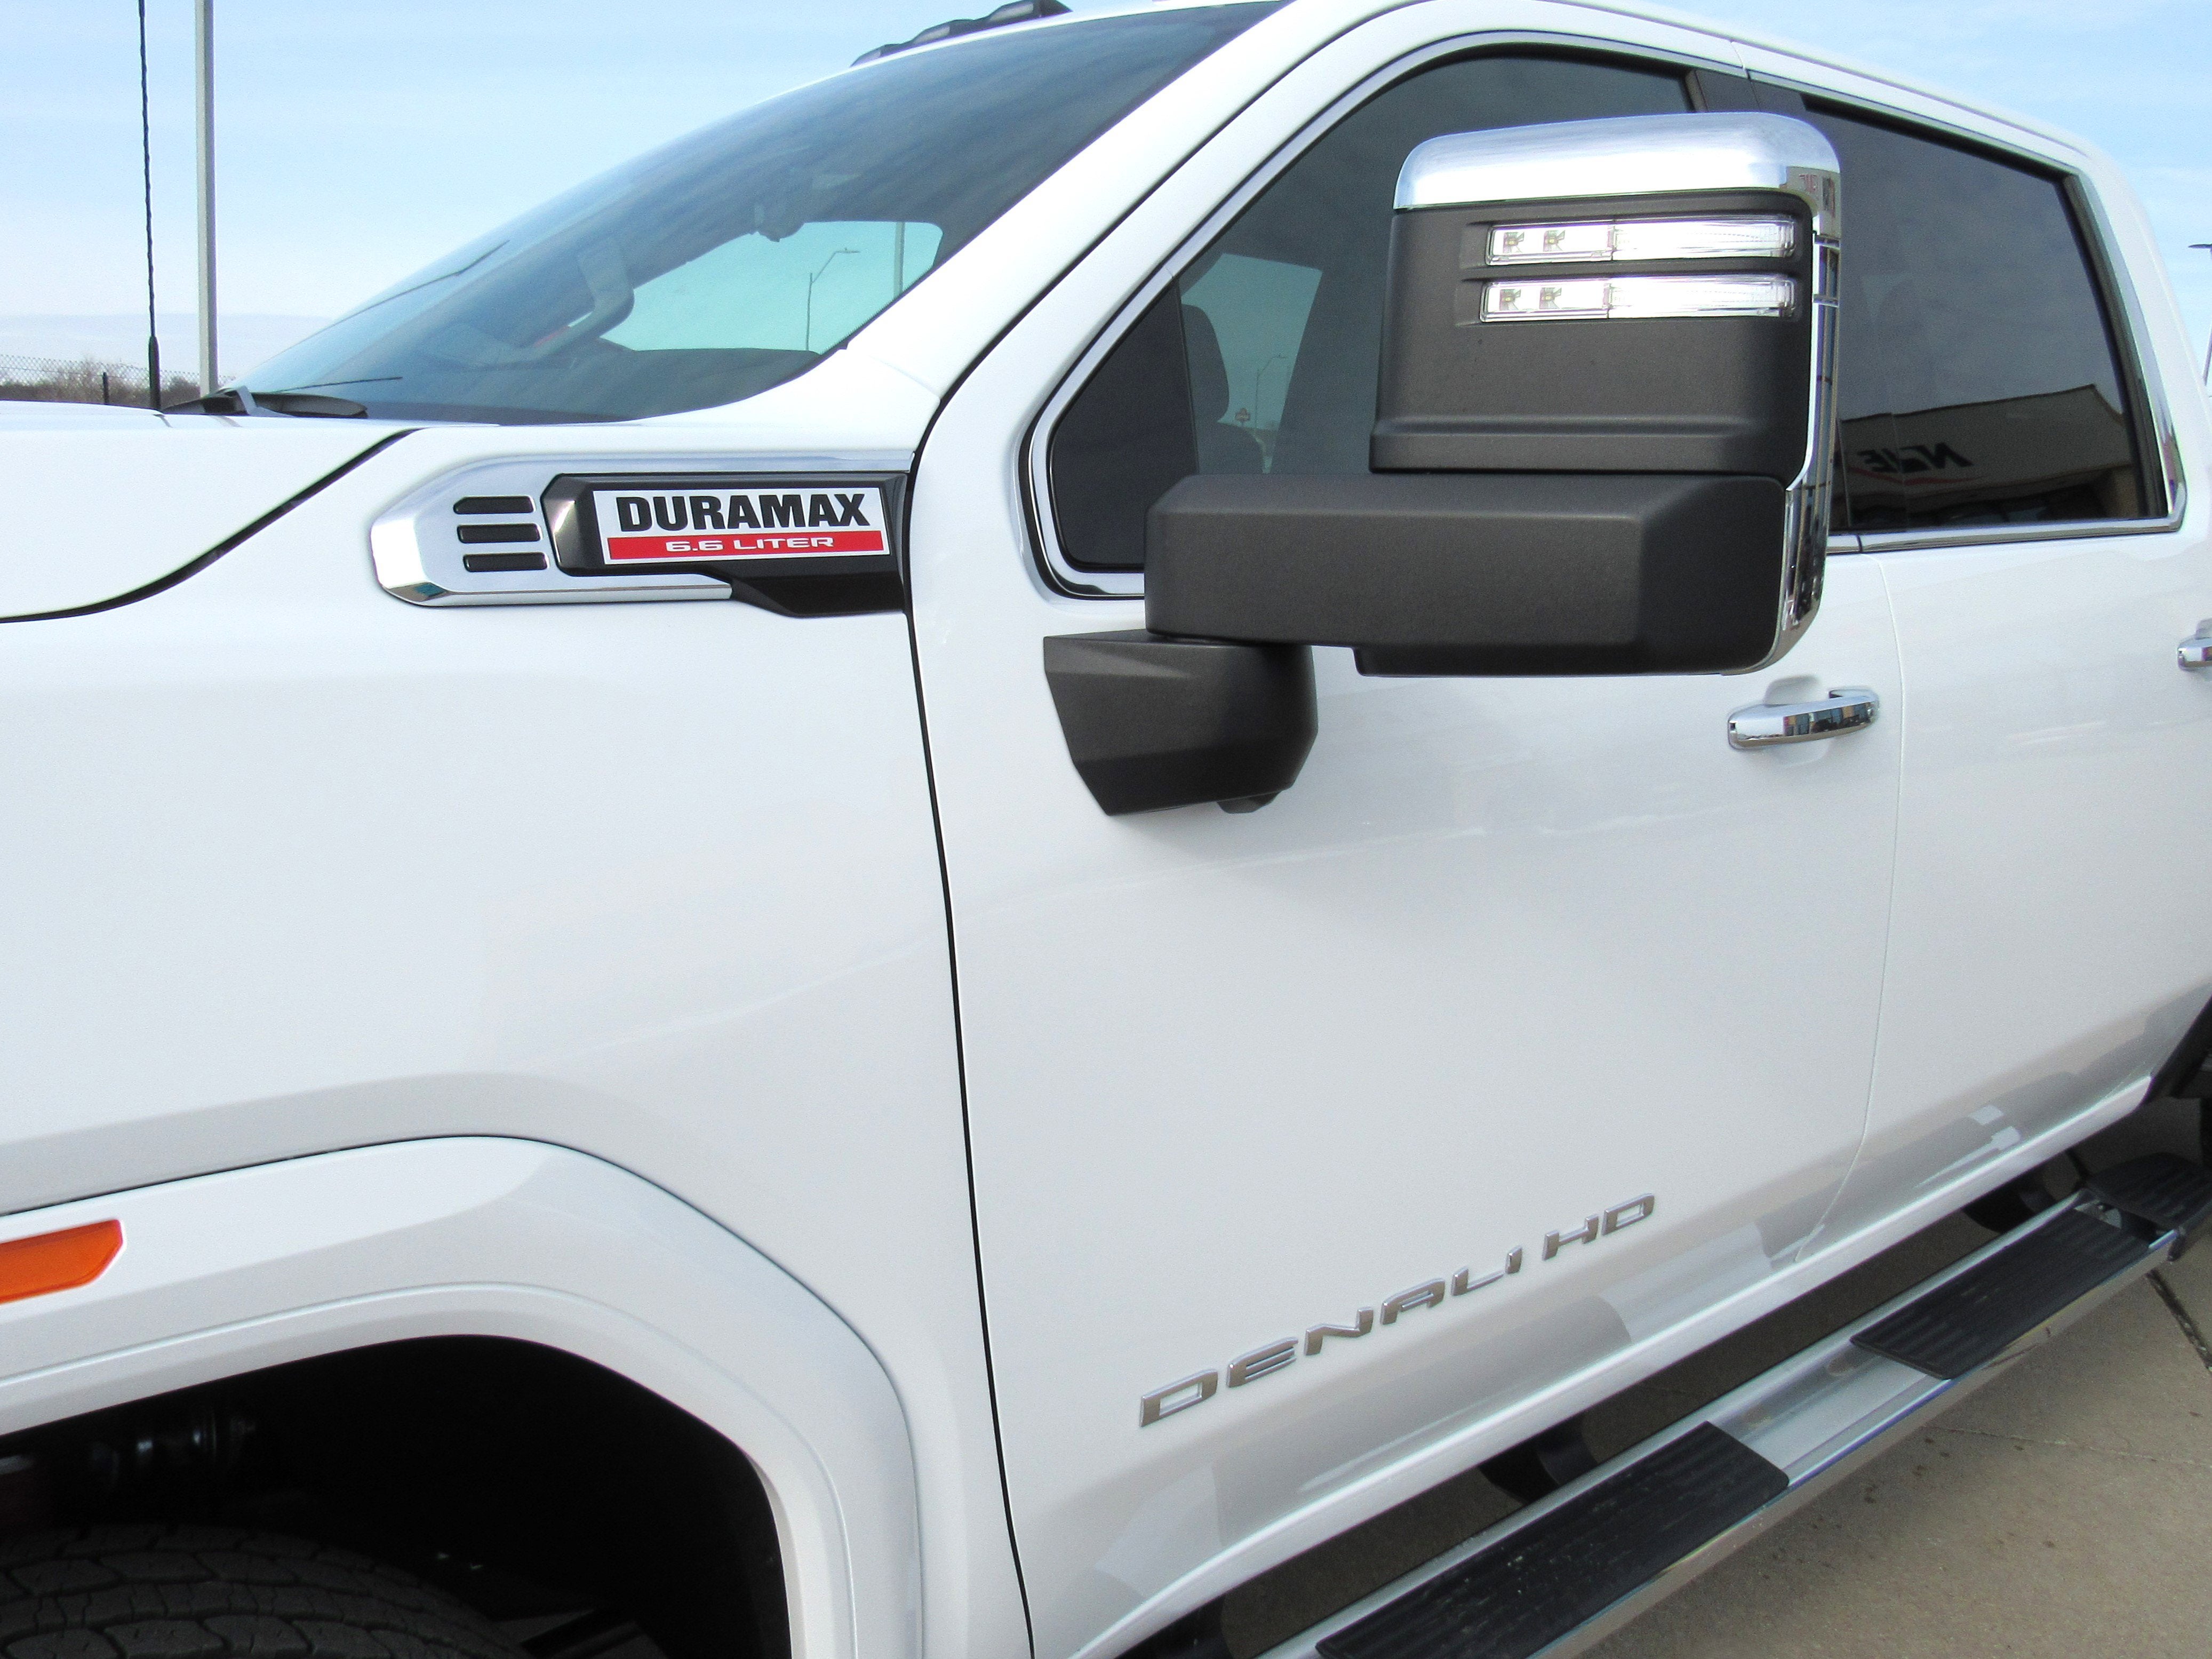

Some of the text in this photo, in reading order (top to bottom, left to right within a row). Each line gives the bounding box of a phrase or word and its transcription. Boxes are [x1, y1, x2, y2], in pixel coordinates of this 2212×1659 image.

[616, 493, 871, 532] DURAMAX
[666, 537, 834, 552] 6.6 LITER
[1139, 1193, 1655, 1427] DENALI HD
